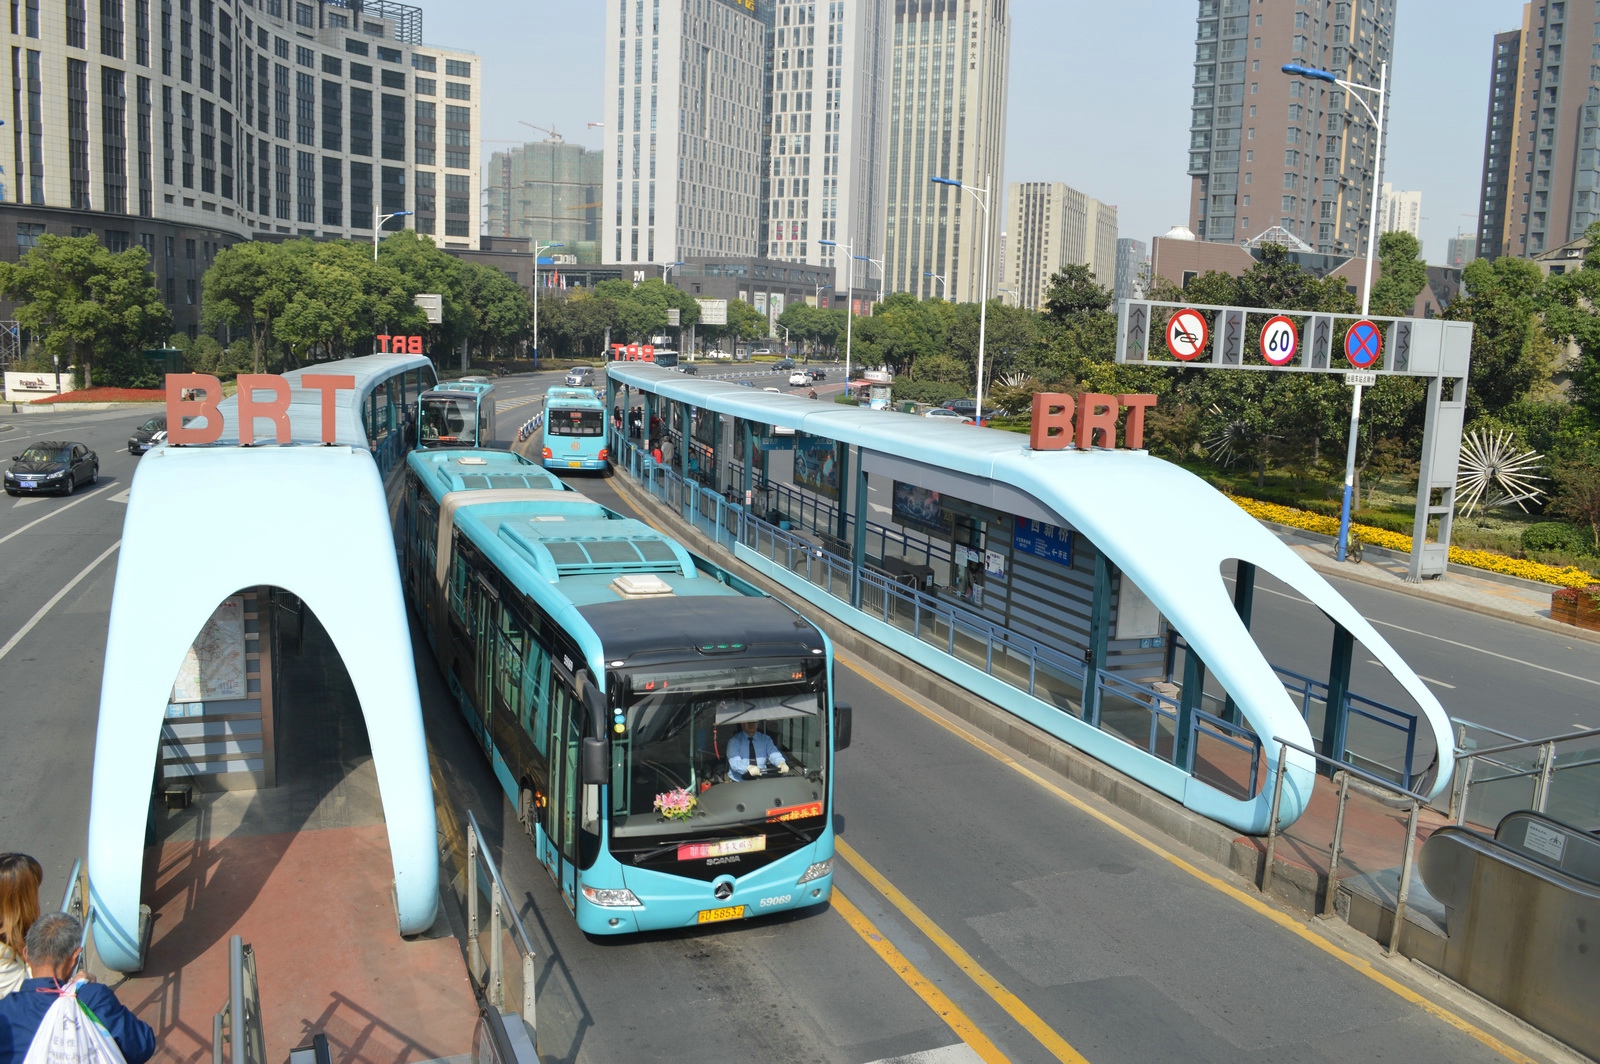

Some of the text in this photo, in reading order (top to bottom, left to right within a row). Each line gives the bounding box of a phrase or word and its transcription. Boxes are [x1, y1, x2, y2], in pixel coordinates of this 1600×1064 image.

[970, 11, 978, 70] 新城国际大厦
[1268, 329, 1290, 352] 60
[165, 373, 355, 445] BRT
[1030, 392, 1158, 450] BRT
[706, 855, 741, 866] SCANIA
[759, 894, 792, 908] 59069
